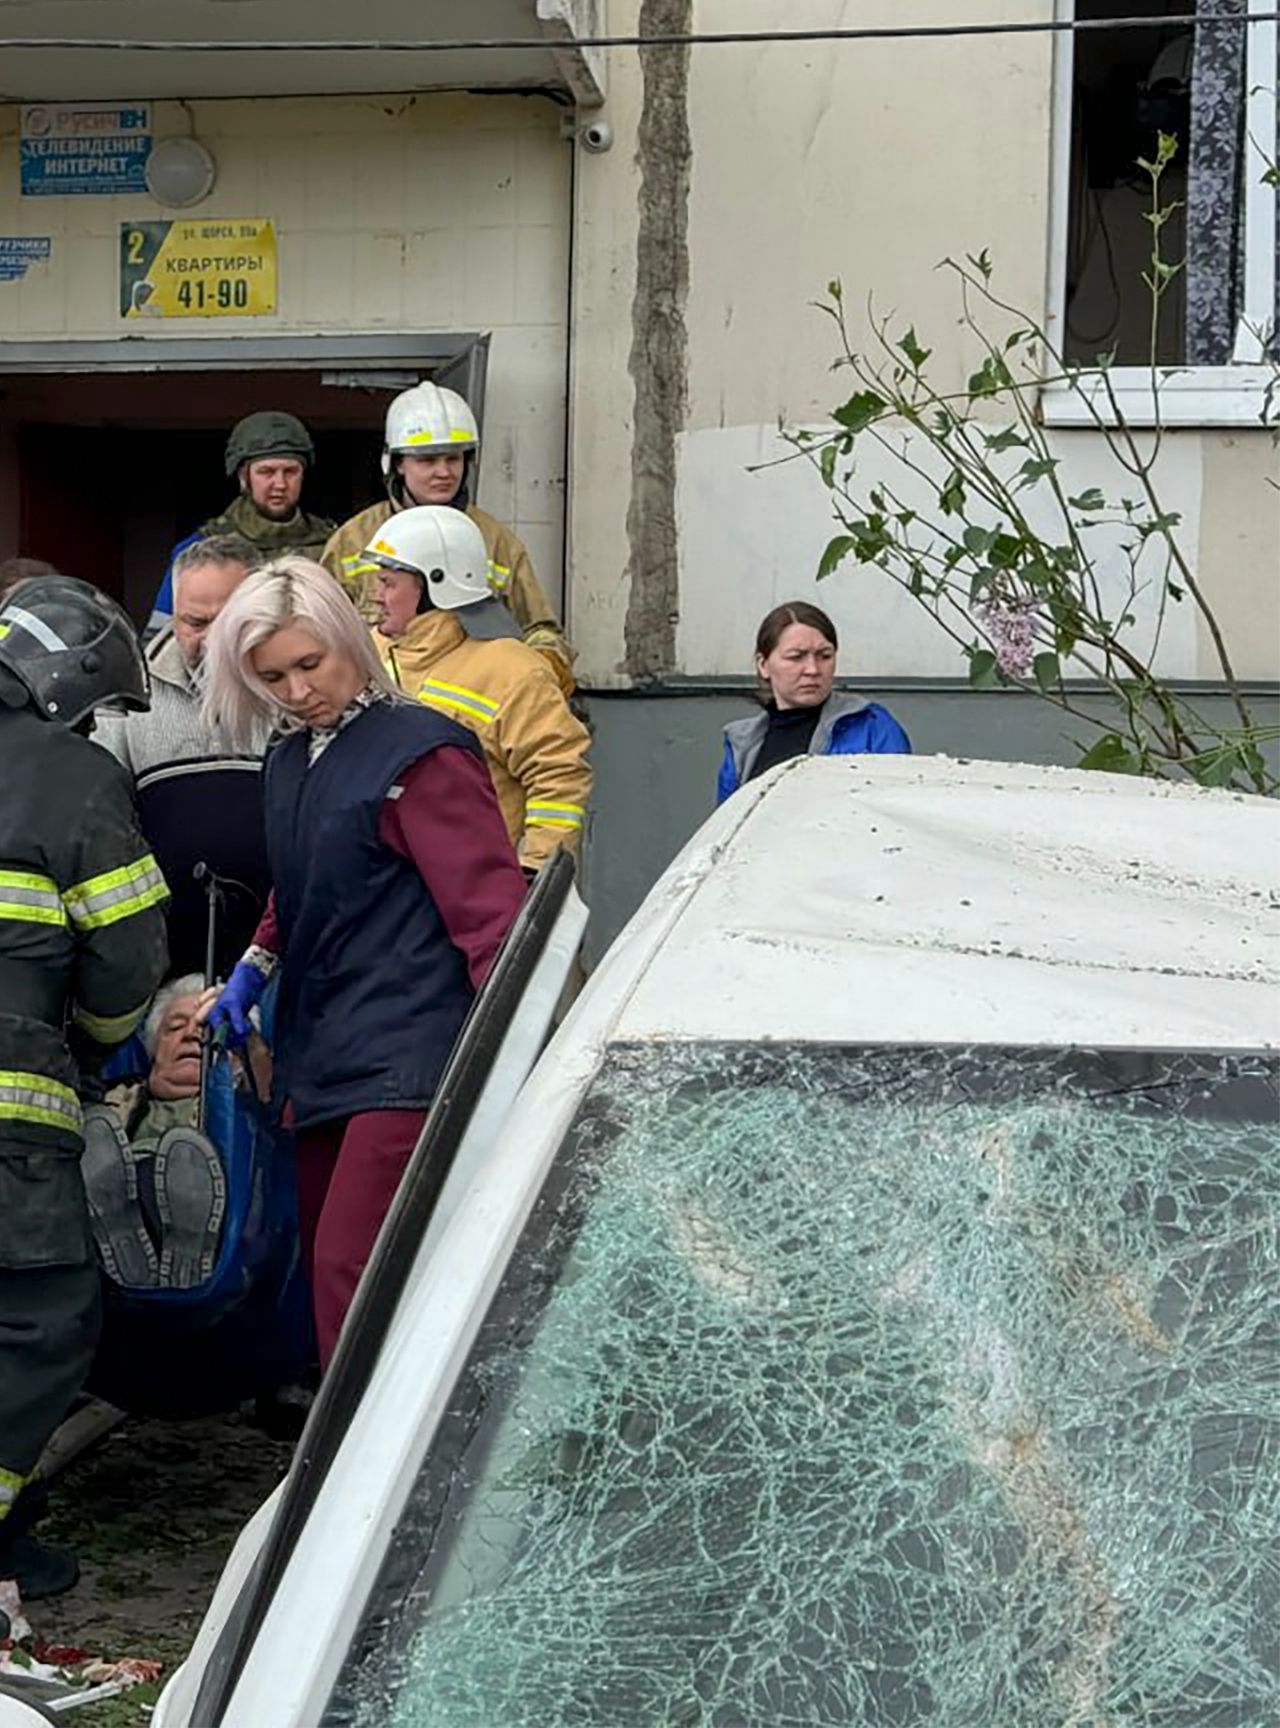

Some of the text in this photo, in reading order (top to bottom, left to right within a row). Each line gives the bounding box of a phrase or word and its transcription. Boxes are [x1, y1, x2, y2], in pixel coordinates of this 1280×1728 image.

[29, 137, 145, 158] ТЕЛЕВИДЕНИЕ
[44, 157, 129, 175] ИНТЕРНЕТ
[127, 231, 145, 264] 2
[166, 256, 263, 273] КВАРТИРЫ
[177, 279, 248, 308] 41-90
